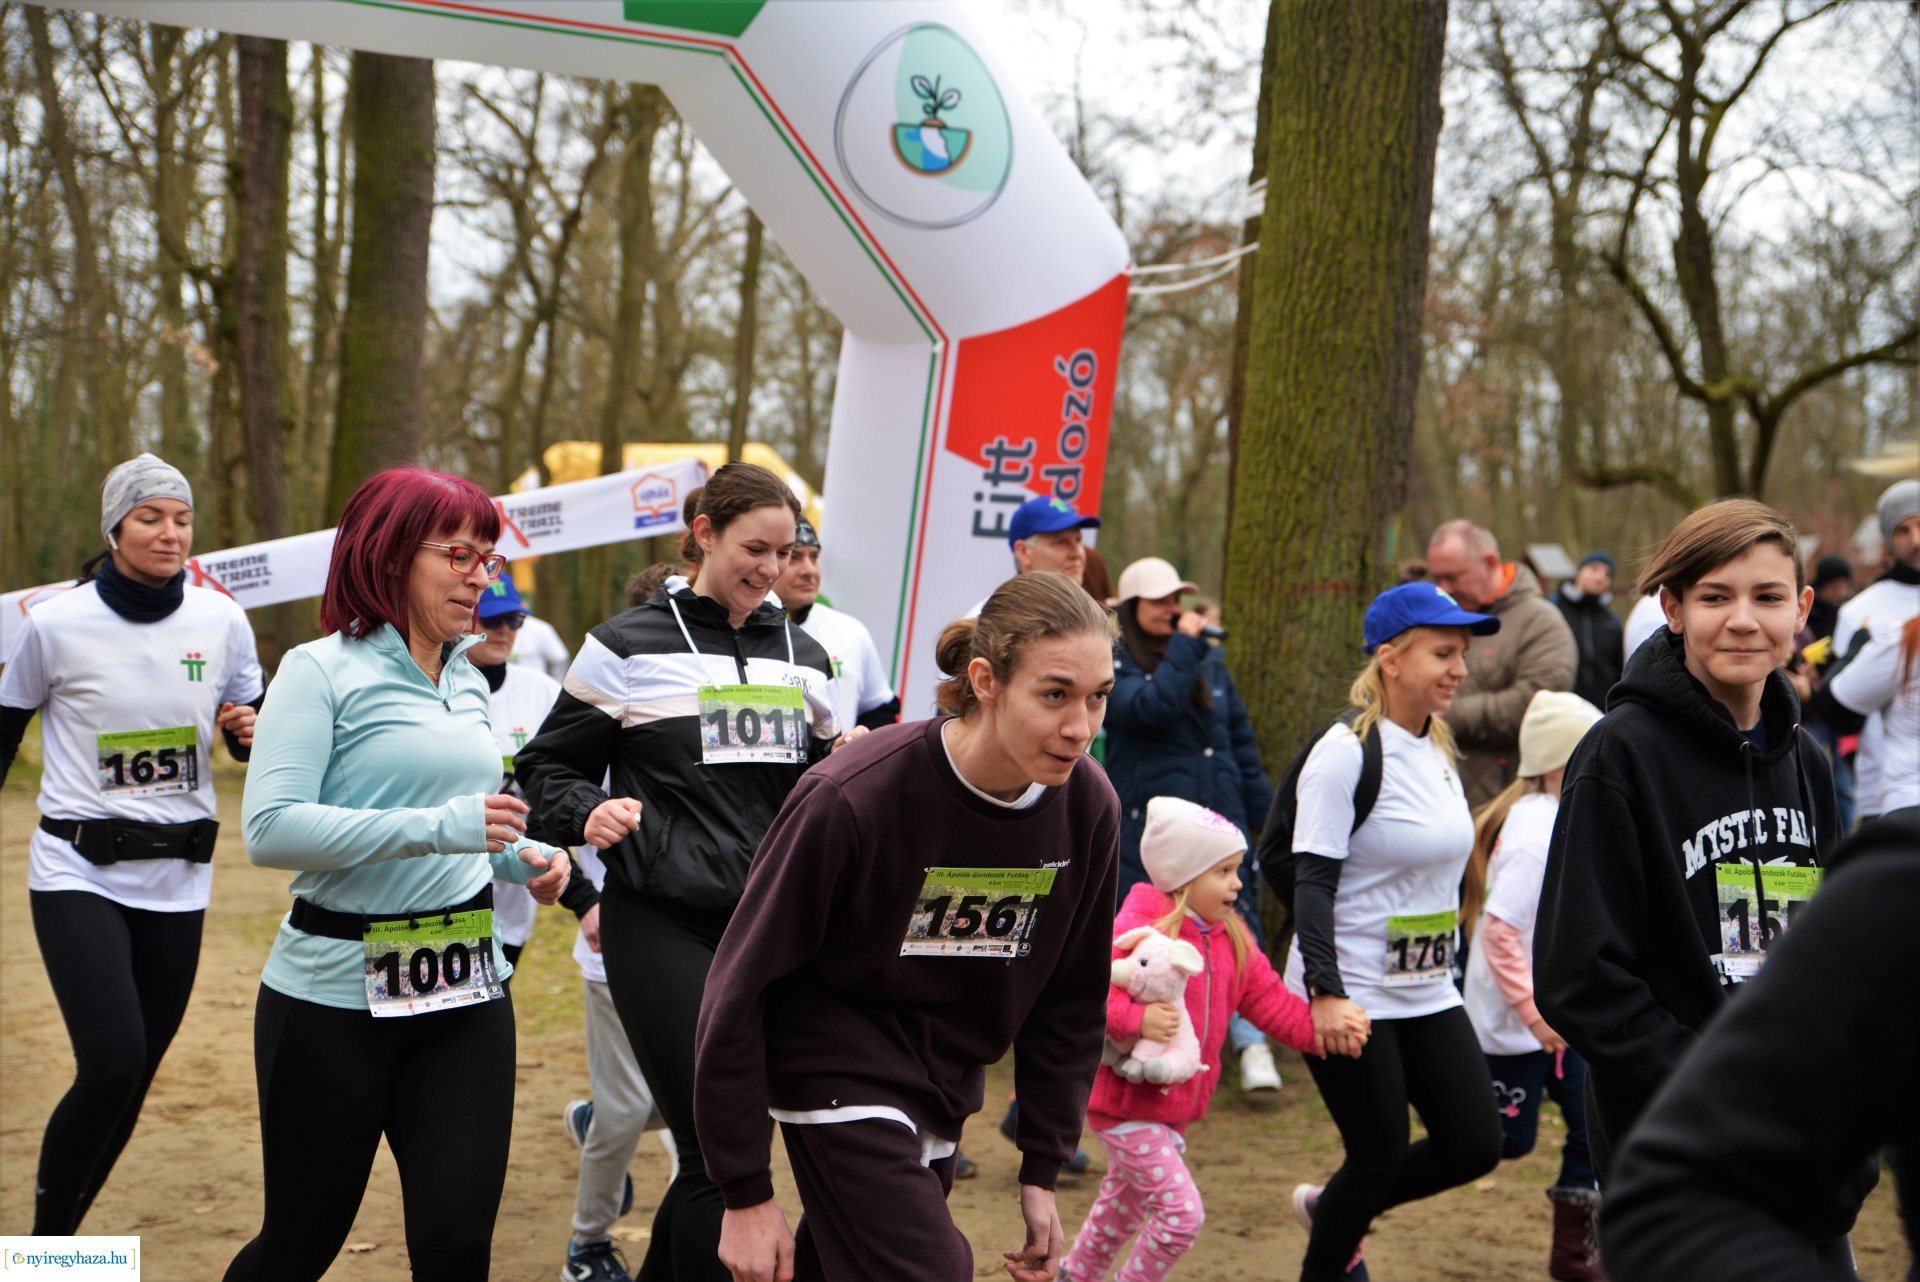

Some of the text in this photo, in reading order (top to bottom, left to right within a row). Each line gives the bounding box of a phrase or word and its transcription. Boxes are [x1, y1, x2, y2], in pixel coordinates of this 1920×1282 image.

[971, 437, 1034, 540] Fitt
[707, 708, 785, 745] 101
[104, 748, 179, 785] 165
[923, 895, 1022, 937] 156
[373, 943, 471, 997] 100
[1392, 932, 1446, 972] 176
